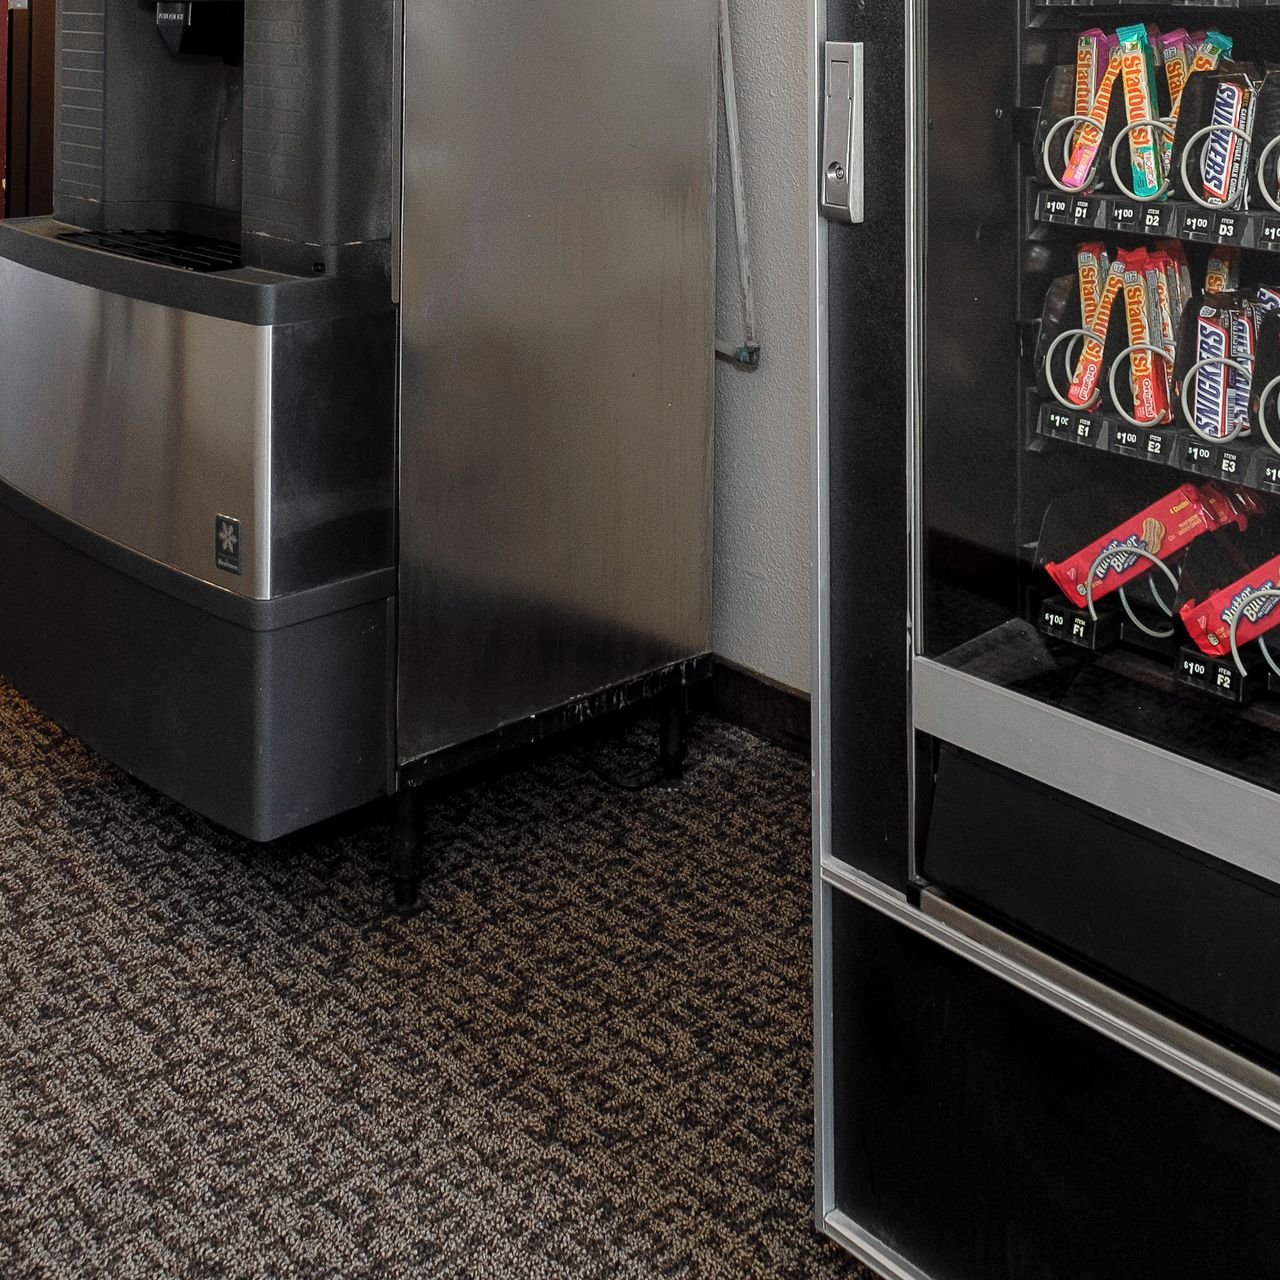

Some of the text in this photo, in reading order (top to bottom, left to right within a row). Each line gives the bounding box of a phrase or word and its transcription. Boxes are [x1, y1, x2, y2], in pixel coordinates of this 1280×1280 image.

[1238, 108, 1247, 131] CARAM
[1075, 207, 1087, 218] D1
[1146, 215, 1159, 226] D2
[1219, 224, 1234, 236] D3
[1079, 364, 1096, 400] Original
[1143, 378, 1154, 417] Original
[1078, 425, 1089, 437] E1
[1148, 441, 1161, 453] E2
[1222, 460, 1236, 472] E3
[1073, 624, 1084, 638] F1
[1217, 675, 1230, 689] F2
